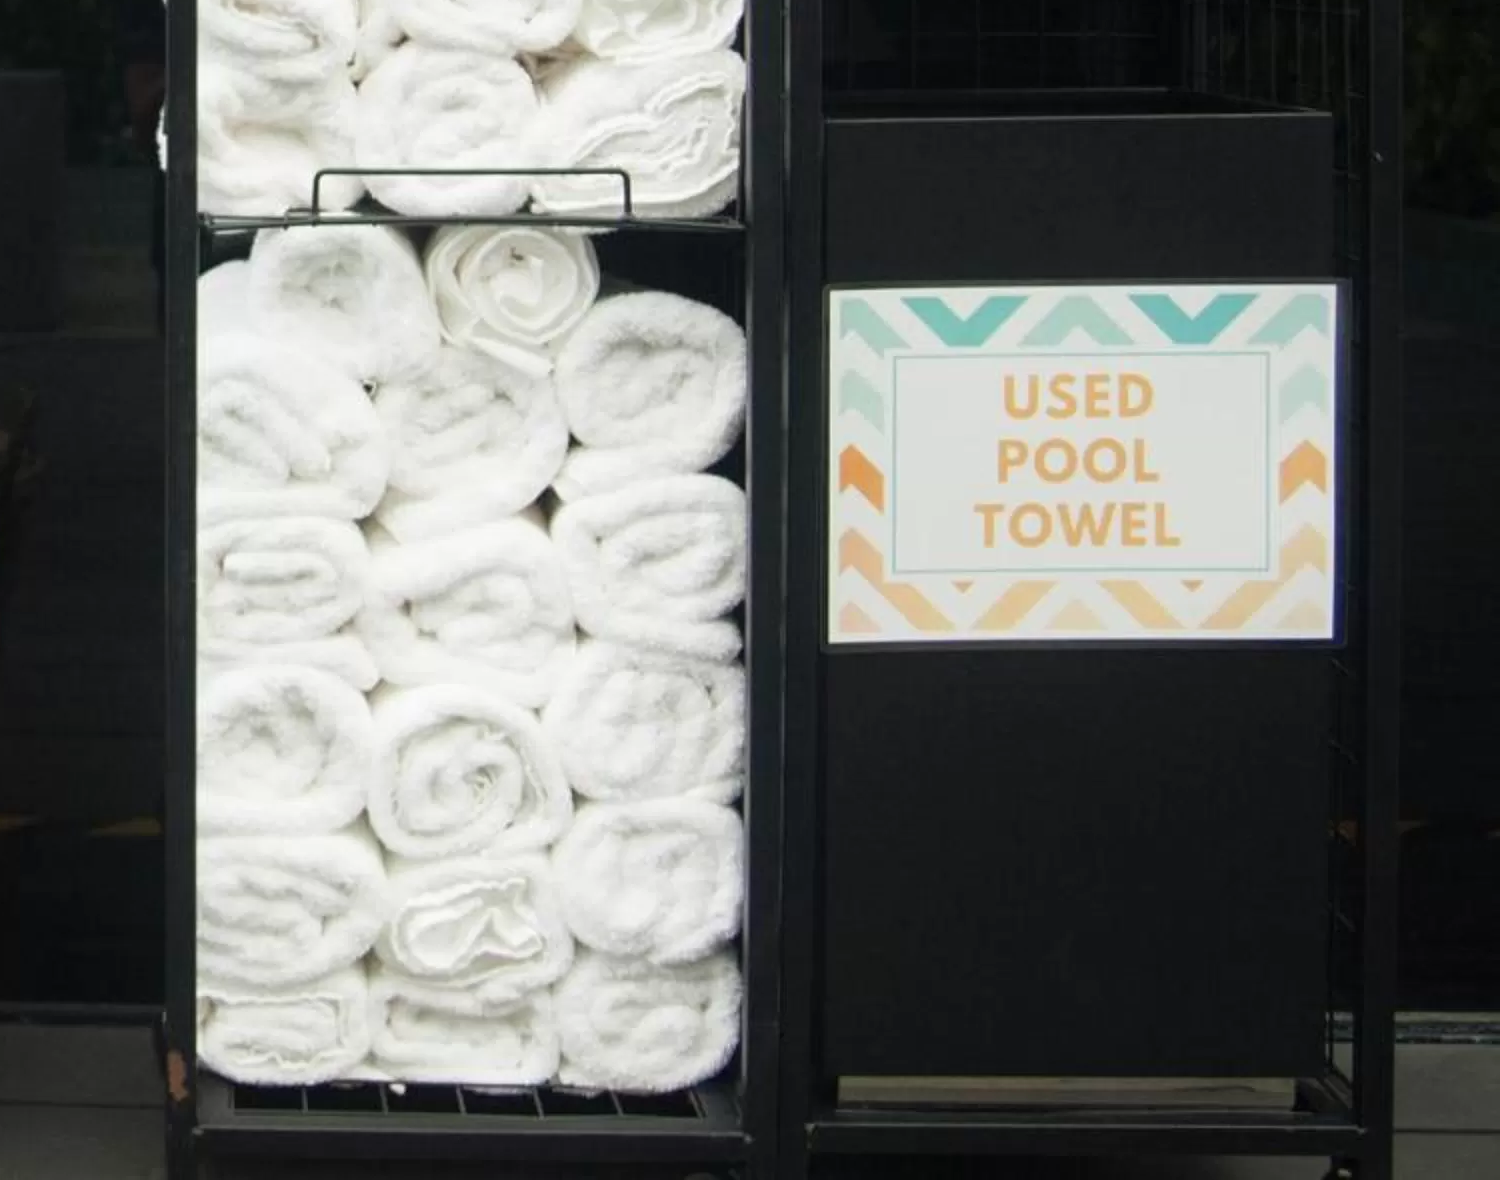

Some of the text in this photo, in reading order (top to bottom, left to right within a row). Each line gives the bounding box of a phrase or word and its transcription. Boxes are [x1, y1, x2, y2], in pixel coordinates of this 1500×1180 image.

[1003, 372, 1155, 421] USED
[997, 437, 1160, 484] POOL
[974, 501, 1182, 548] TOWEL
